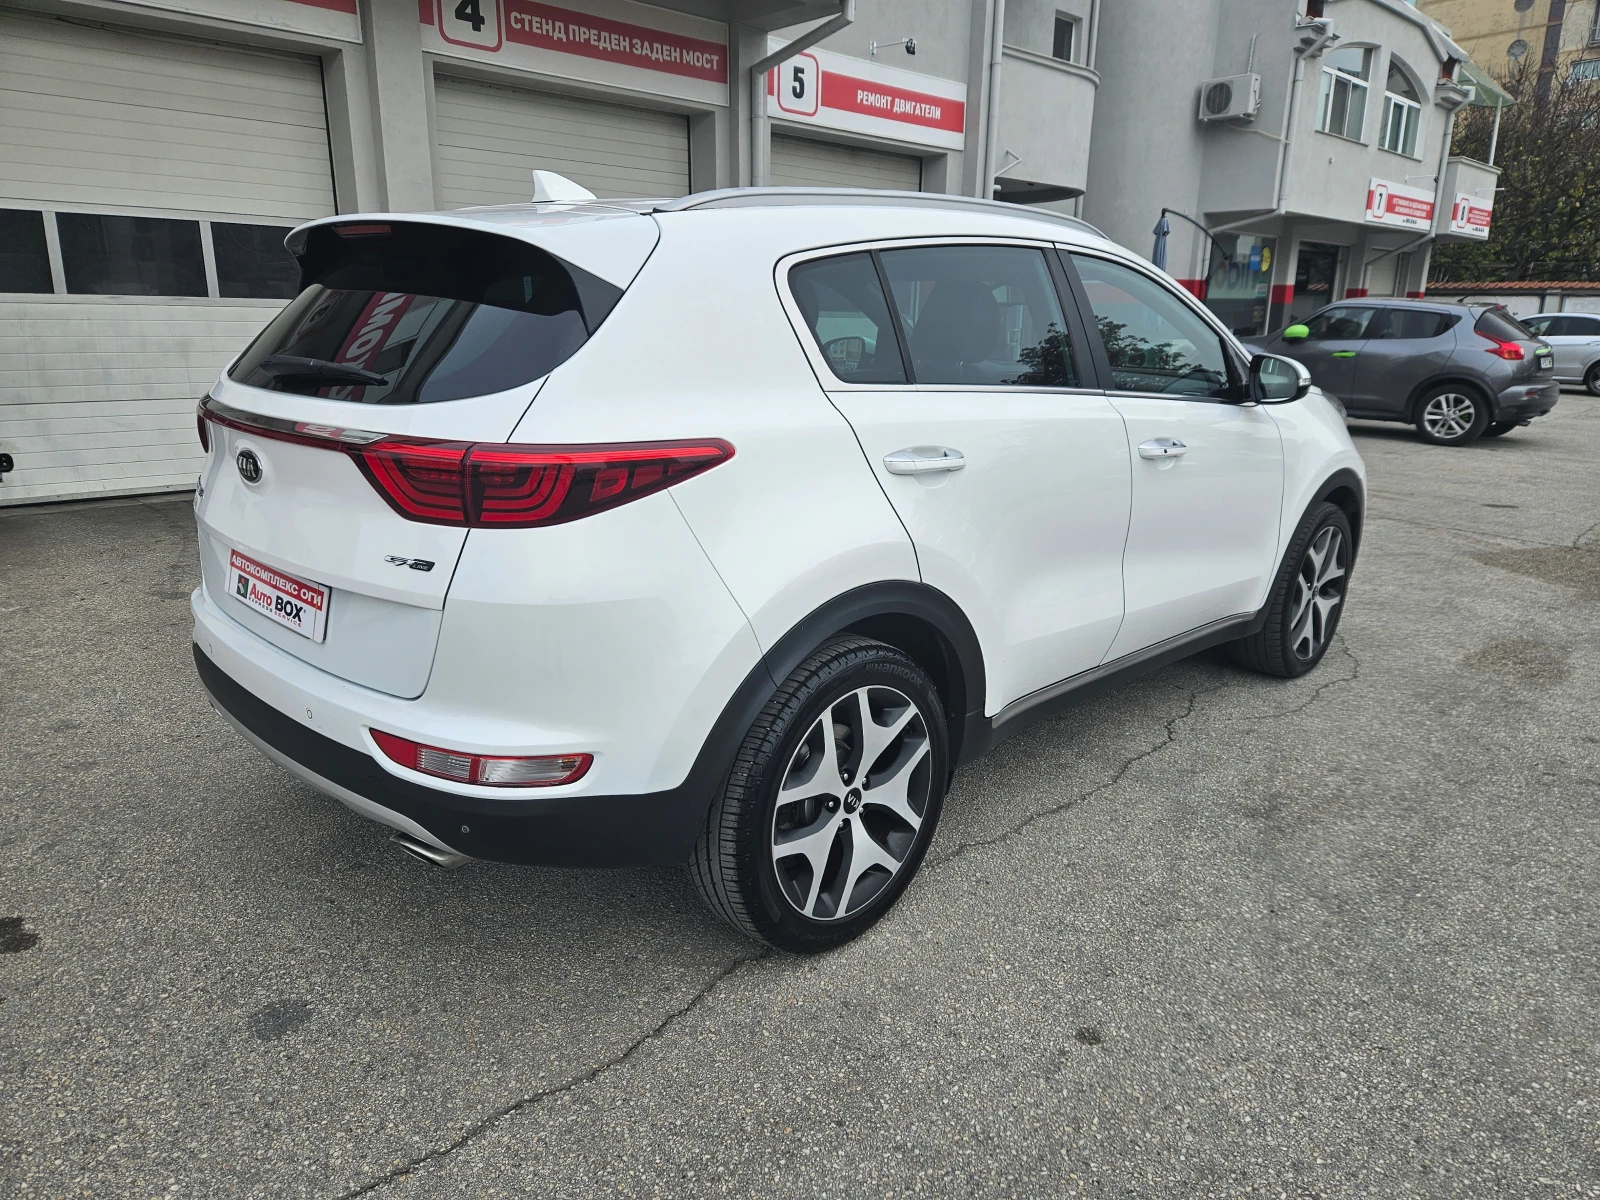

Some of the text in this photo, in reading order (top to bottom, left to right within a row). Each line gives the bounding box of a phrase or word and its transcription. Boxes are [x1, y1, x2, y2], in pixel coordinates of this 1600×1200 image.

[455, 0, 486, 33] 4
[510, 11, 720, 70] СТЕНД ПРЕДЕН ЗАДЕН МОСТ
[792, 65, 805, 99] 5
[857, 89, 942, 120] РЕМОНТ ДВИГАТЕЛИ
[1377, 193, 1383, 210] 7
[231, 554, 322, 607] АВТОКОМПЛЕКС ОГИ
[248, 596, 302, 628] EXPRESS SERVICE
[847, 793, 860, 809] KIA
